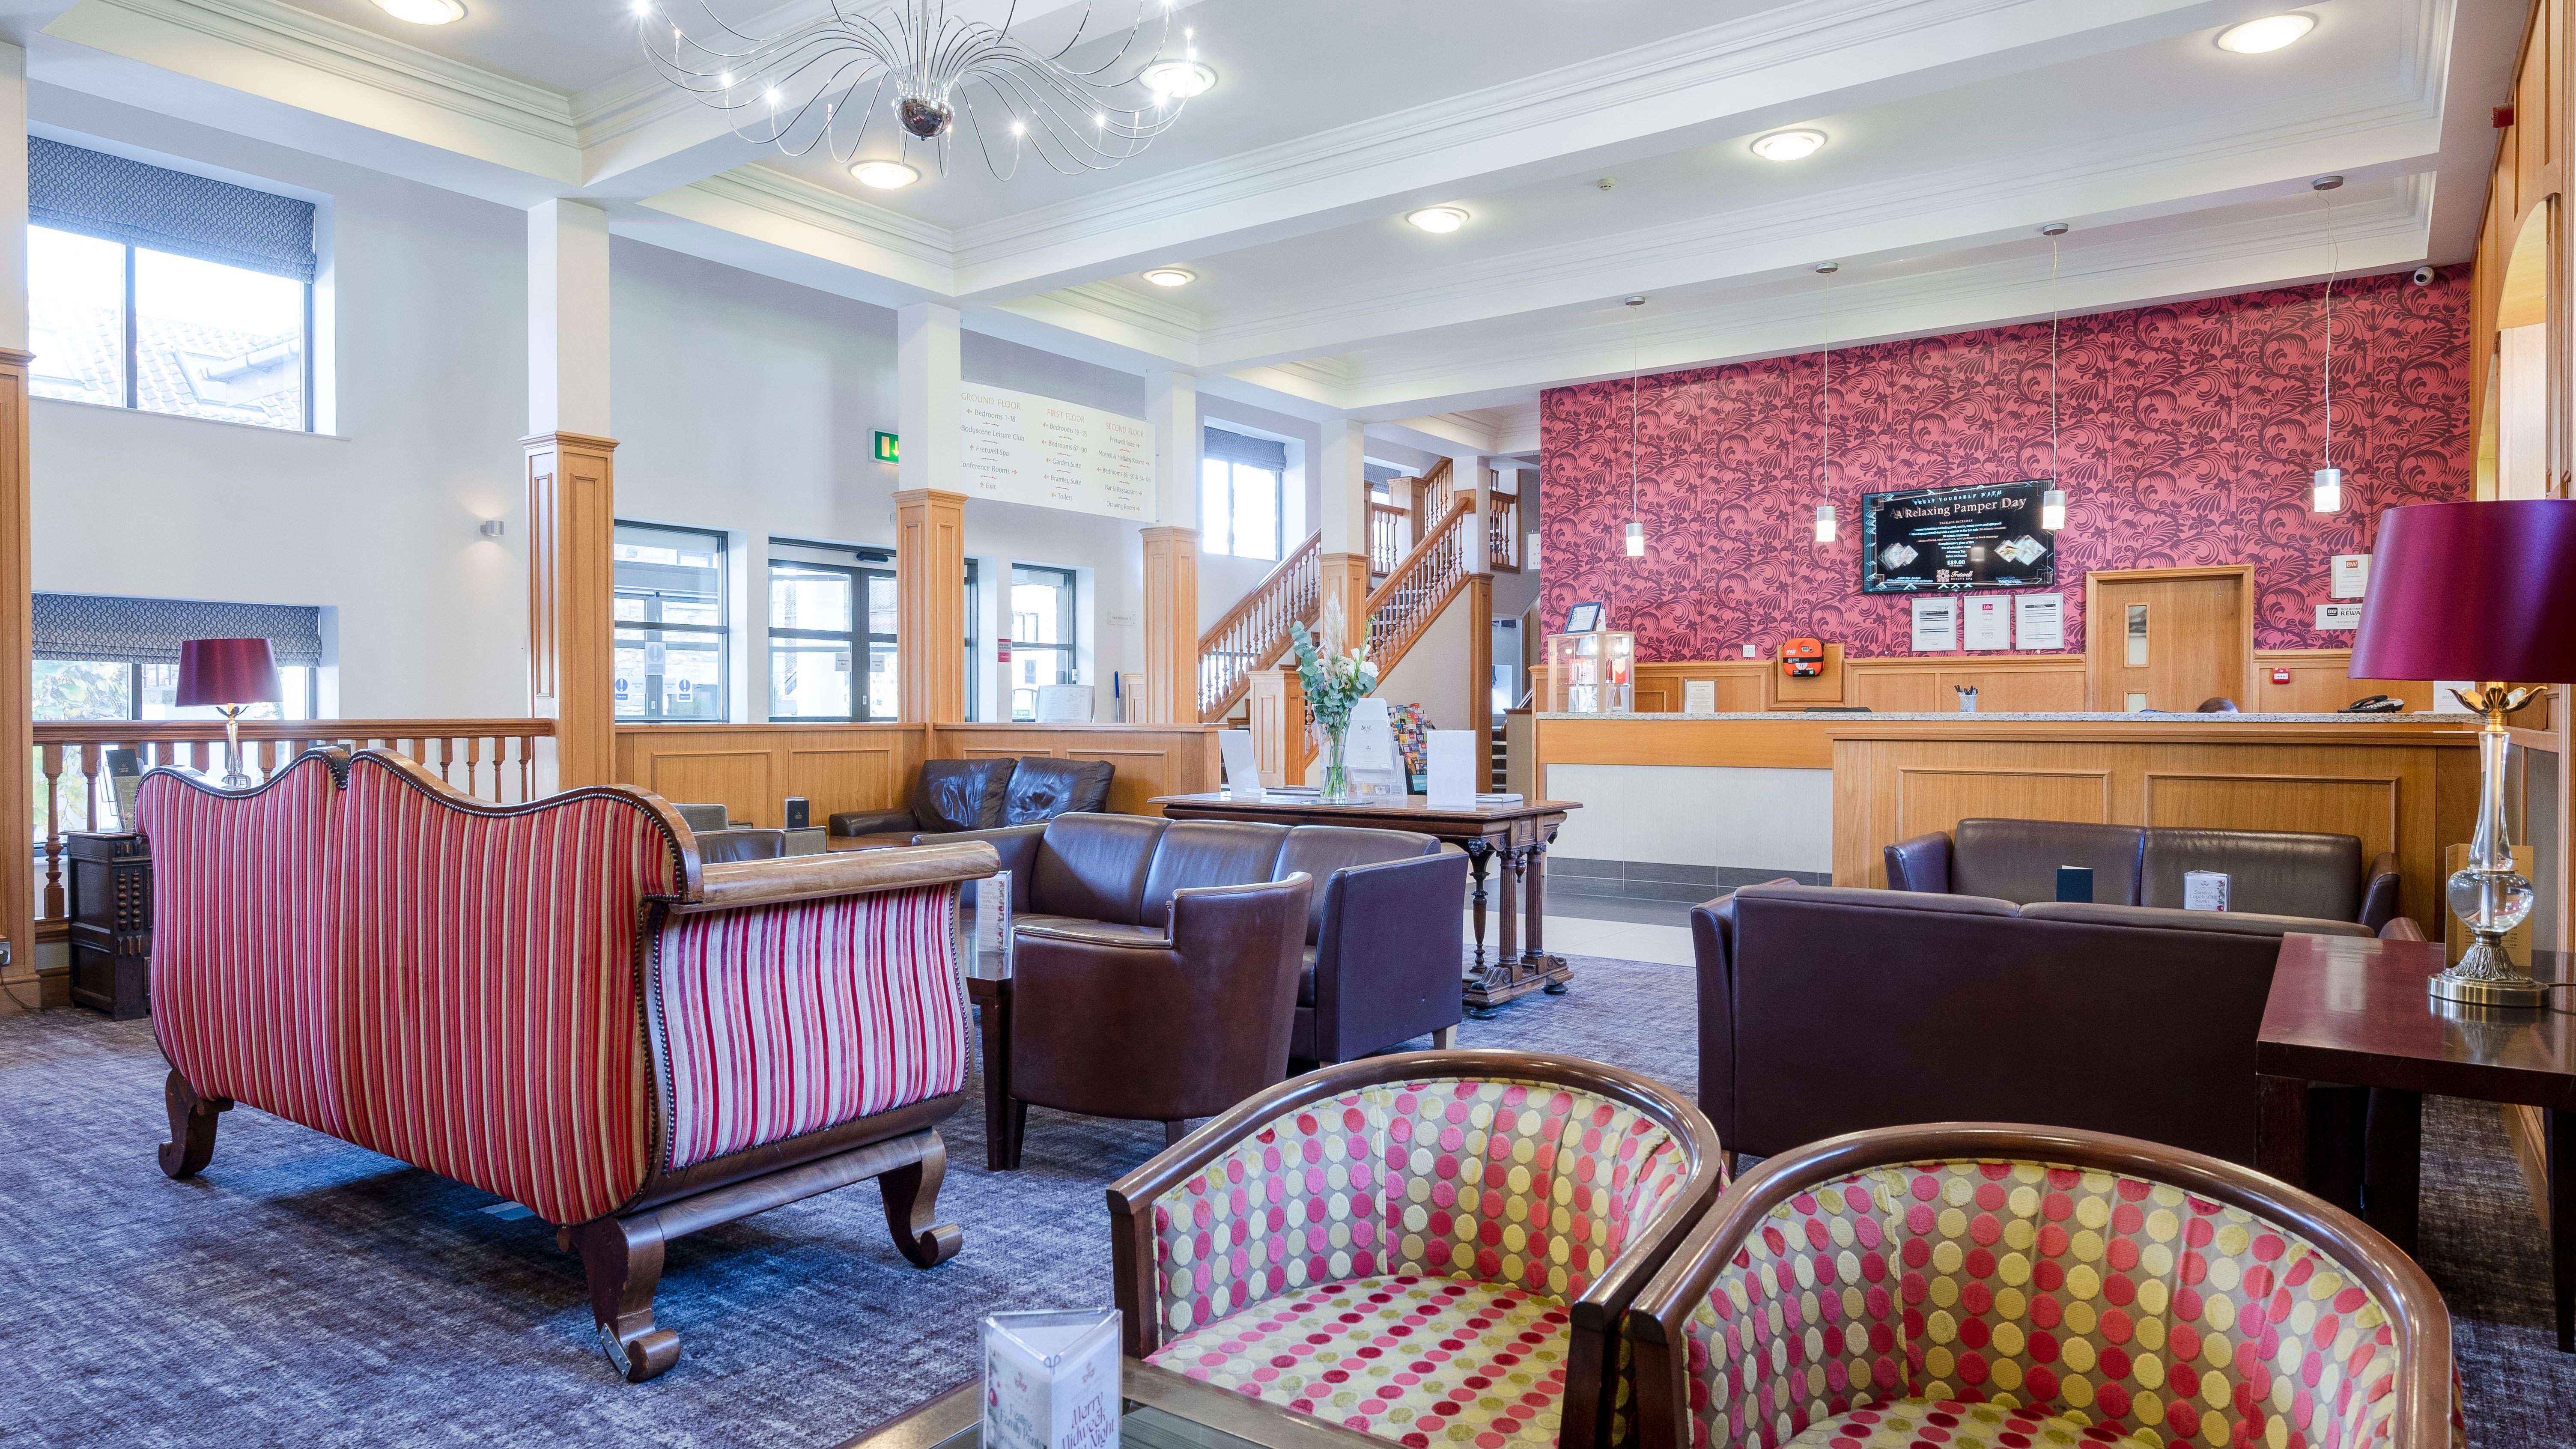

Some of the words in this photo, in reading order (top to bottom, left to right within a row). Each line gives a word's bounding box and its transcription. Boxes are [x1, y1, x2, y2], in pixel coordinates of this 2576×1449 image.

[961, 392, 994, 405] GROUND
[997, 399, 1021, 410] FLOOR
[975, 409, 1003, 420] Bedrooms
[1047, 408, 1063, 418] FIRST
[1066, 413, 1085, 423] FLOOR
[961, 425, 991, 436] Bodyscene
[993, 430, 1011, 439] Leisure
[1050, 423, 1073, 433] Bedrooms
[1106, 422, 1127, 433] SECOND
[1128, 428, 1144, 438] FLOOR
[1049, 440, 1072, 450] Bedrooms
[1110, 436, 1125, 445] Fretwell
[976, 445, 998, 455] Fretwell
[1052, 458, 1070, 467] Garden
[1098, 450, 1112, 459] Morrell
[1118, 454, 1132, 464] Hellaby
[1132, 457, 1145, 465] Rooms
[961, 461, 990, 471] onference
[992, 465, 1010, 474] Rooms
[1103, 467, 1122, 477] Bedrooms
[1051, 474, 1070, 485] Bramley
[1117, 486, 1137, 495] Restaurant
[1939, 493, 1977, 502] YOURSELF
[1980, 490, 2002, 498] WITH
[1058, 493, 1073, 501] Toilets
[1106, 501, 1123, 510] Drawing
[1905, 505, 1951, 519] Relaxing
[1954, 501, 1998, 514] Pamper
[2001, 497, 2027, 510] Day
[1072, 1391, 1103, 1429] Merry
[1062, 1406, 1106, 1449] Midweek
[1091, 1416, 1114, 1448] Night
